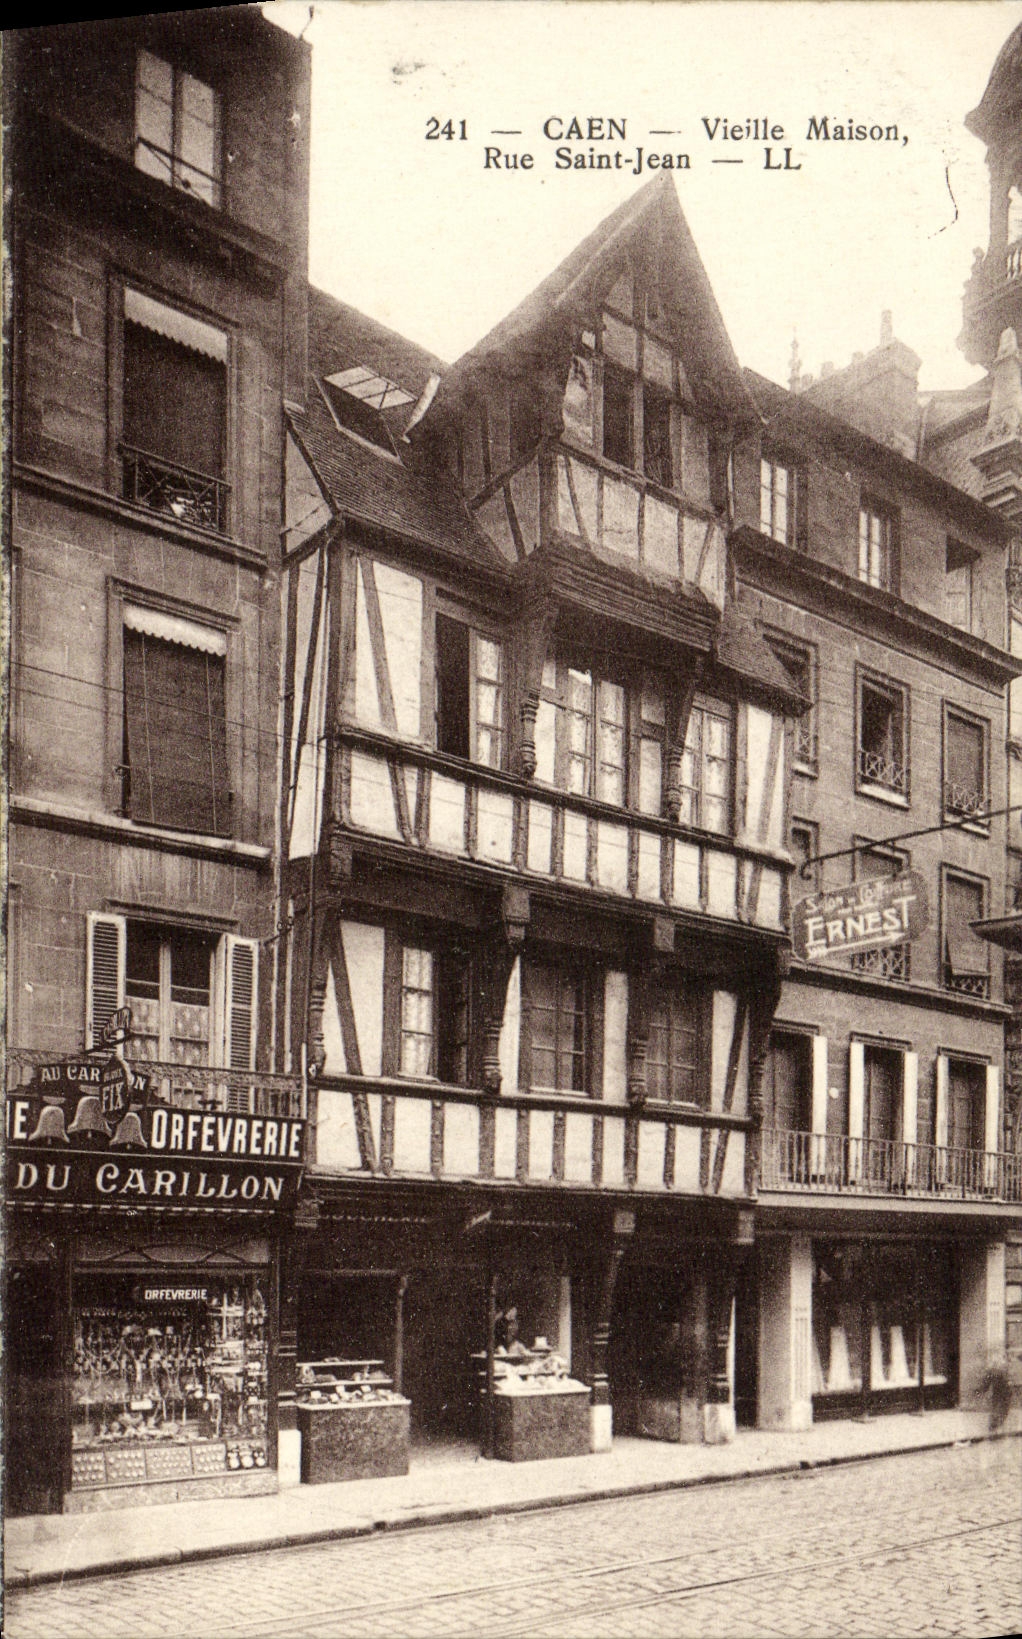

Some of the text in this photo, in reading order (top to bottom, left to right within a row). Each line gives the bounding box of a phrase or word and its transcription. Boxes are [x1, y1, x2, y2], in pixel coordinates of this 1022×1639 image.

[804, 895, 917, 947] ERNEST
[41, 1067, 61, 1082] AU
[14, 1162, 285, 1200] DU CARILLON
